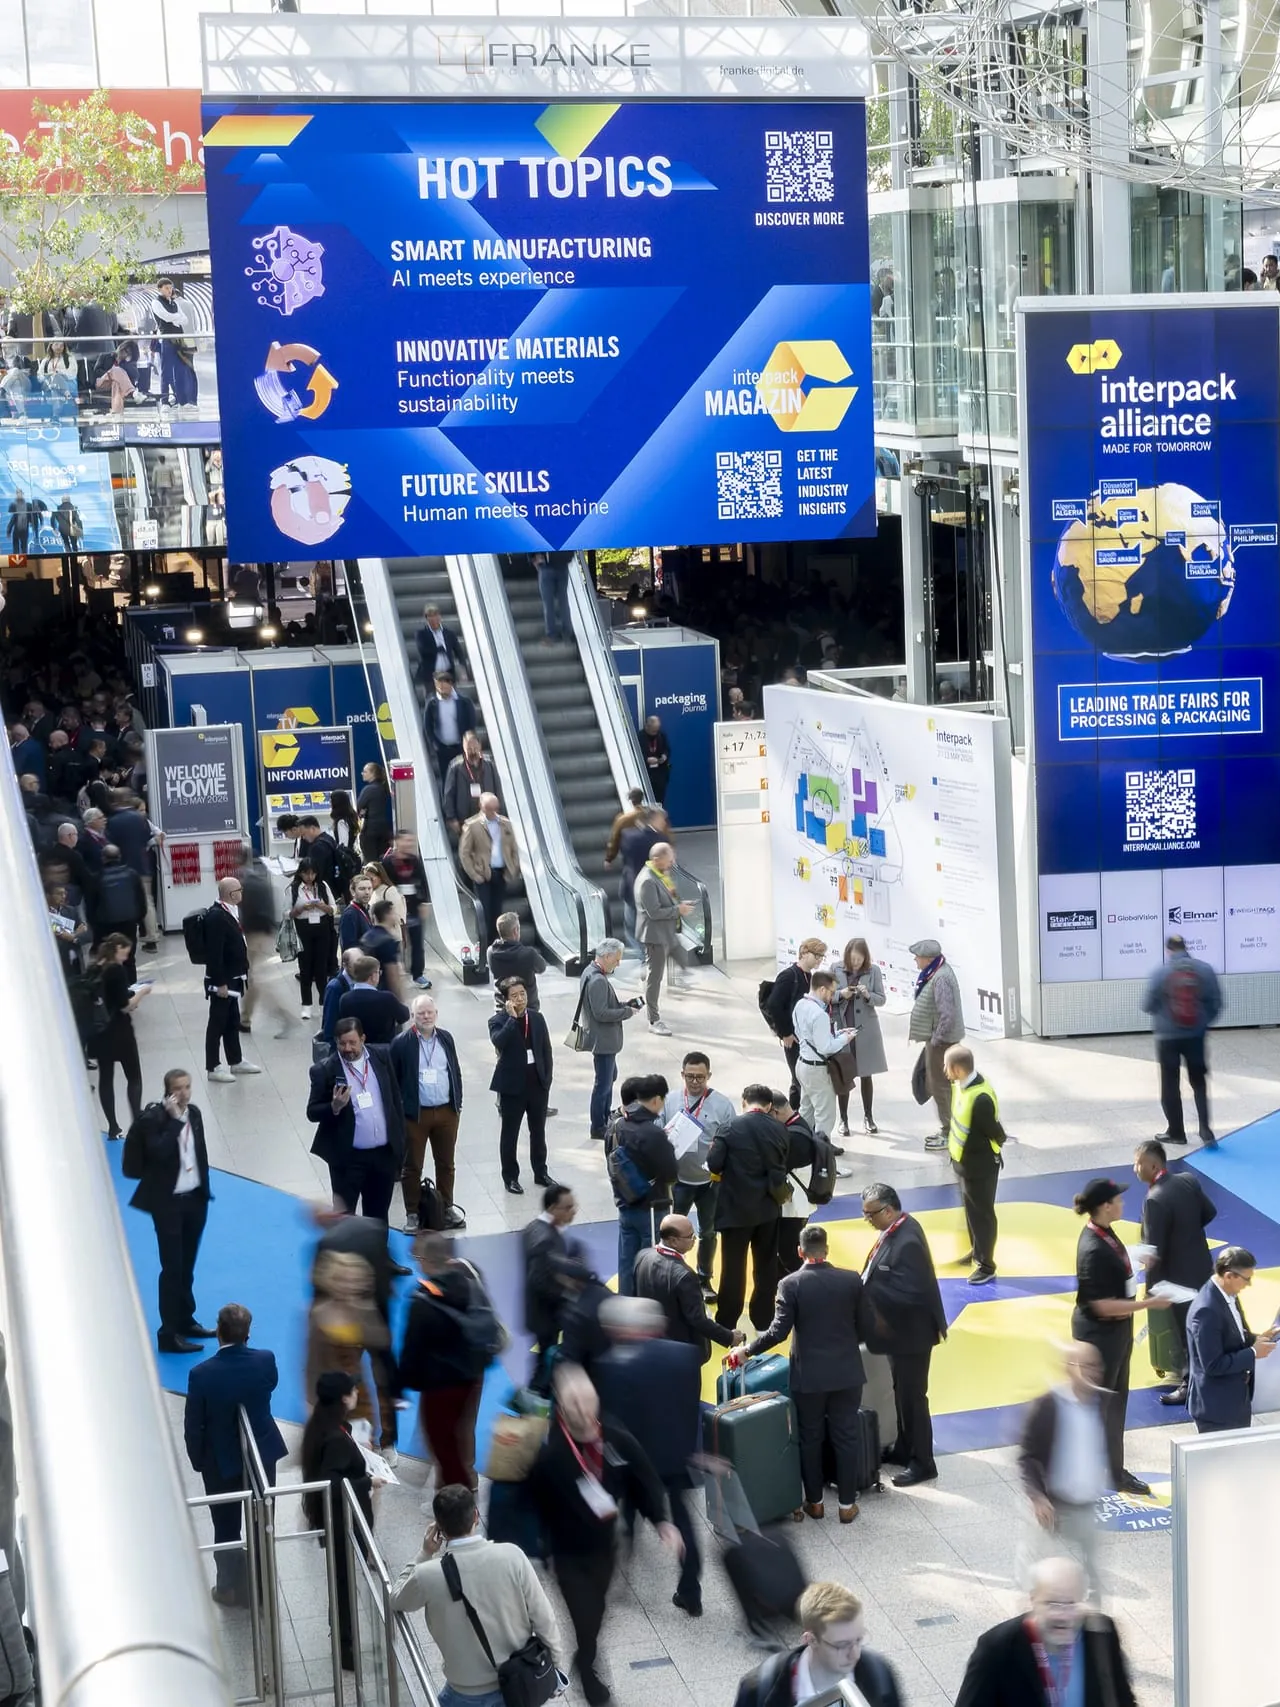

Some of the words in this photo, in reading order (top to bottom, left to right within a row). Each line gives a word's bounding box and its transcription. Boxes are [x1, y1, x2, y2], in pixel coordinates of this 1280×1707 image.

[488, 43, 652, 67] FRANKE
[418, 157, 504, 200] HOT
[520, 155, 673, 199] TOPICS
[755, 213, 810, 228] DISCOVER
[812, 212, 845, 226] MORE
[391, 239, 466, 262] SMART
[473, 237, 652, 261] MANUFACTURING
[392, 270, 411, 287] AI
[418, 269, 473, 286] meets
[479, 267, 575, 288] experience
[396, 338, 509, 363] INNOVATIVE
[516, 335, 620, 360] MATERIALS
[398, 368, 515, 389] Functionality
[521, 367, 575, 385] meets
[733, 366, 799, 386] interpack
[1101, 372, 1237, 408] interpack
[398, 393, 519, 414] sustainability
[704, 387, 802, 416] MAGAZIN
[1100, 408, 1212, 438] alliance
[797, 449, 816, 462] GET
[819, 449, 839, 462] THE
[1102, 443, 1130, 454] MADE
[1133, 443, 1152, 453] FOR
[1156, 441, 1212, 453] TOMORROW
[798, 467, 833, 480] LATEST
[402, 472, 478, 497] FUTURE
[484, 470, 550, 494] SKILLS
[798, 484, 848, 497] INDUSTRY
[1102, 488, 1134, 496] GERMANY
[404, 504, 468, 522] Human
[475, 502, 529, 520] meets
[535, 498, 609, 517] machine
[799, 502, 846, 516] INSIGHTS
[1055, 509, 1084, 517] ALGERIA
[1233, 534, 1275, 543] PHILIPPINES
[655, 691, 707, 708] packaging
[1070, 695, 1128, 713] LEADING
[1132, 693, 1176, 711] TRADE
[1180, 692, 1219, 709] FAIRS
[1223, 690, 1250, 708] FOR
[682, 703, 708, 715] journal
[278, 716, 298, 730] TV
[1070, 712, 1157, 728] PROCESSING
[1161, 712, 1171, 725] &
[1174, 709, 1251, 724] PACKAGING
[321, 734, 346, 742] interpack
[935, 728, 973, 747] interpack
[731, 741, 745, 752] 17
[164, 762, 226, 780] WELCOME
[267, 766, 350, 783] INFORMATION
[166, 777, 228, 799] HOME
[189, 795, 206, 804] MAY
[1117, 913, 1158, 922] GlobalVision
[1183, 911, 1218, 919] Elmar
